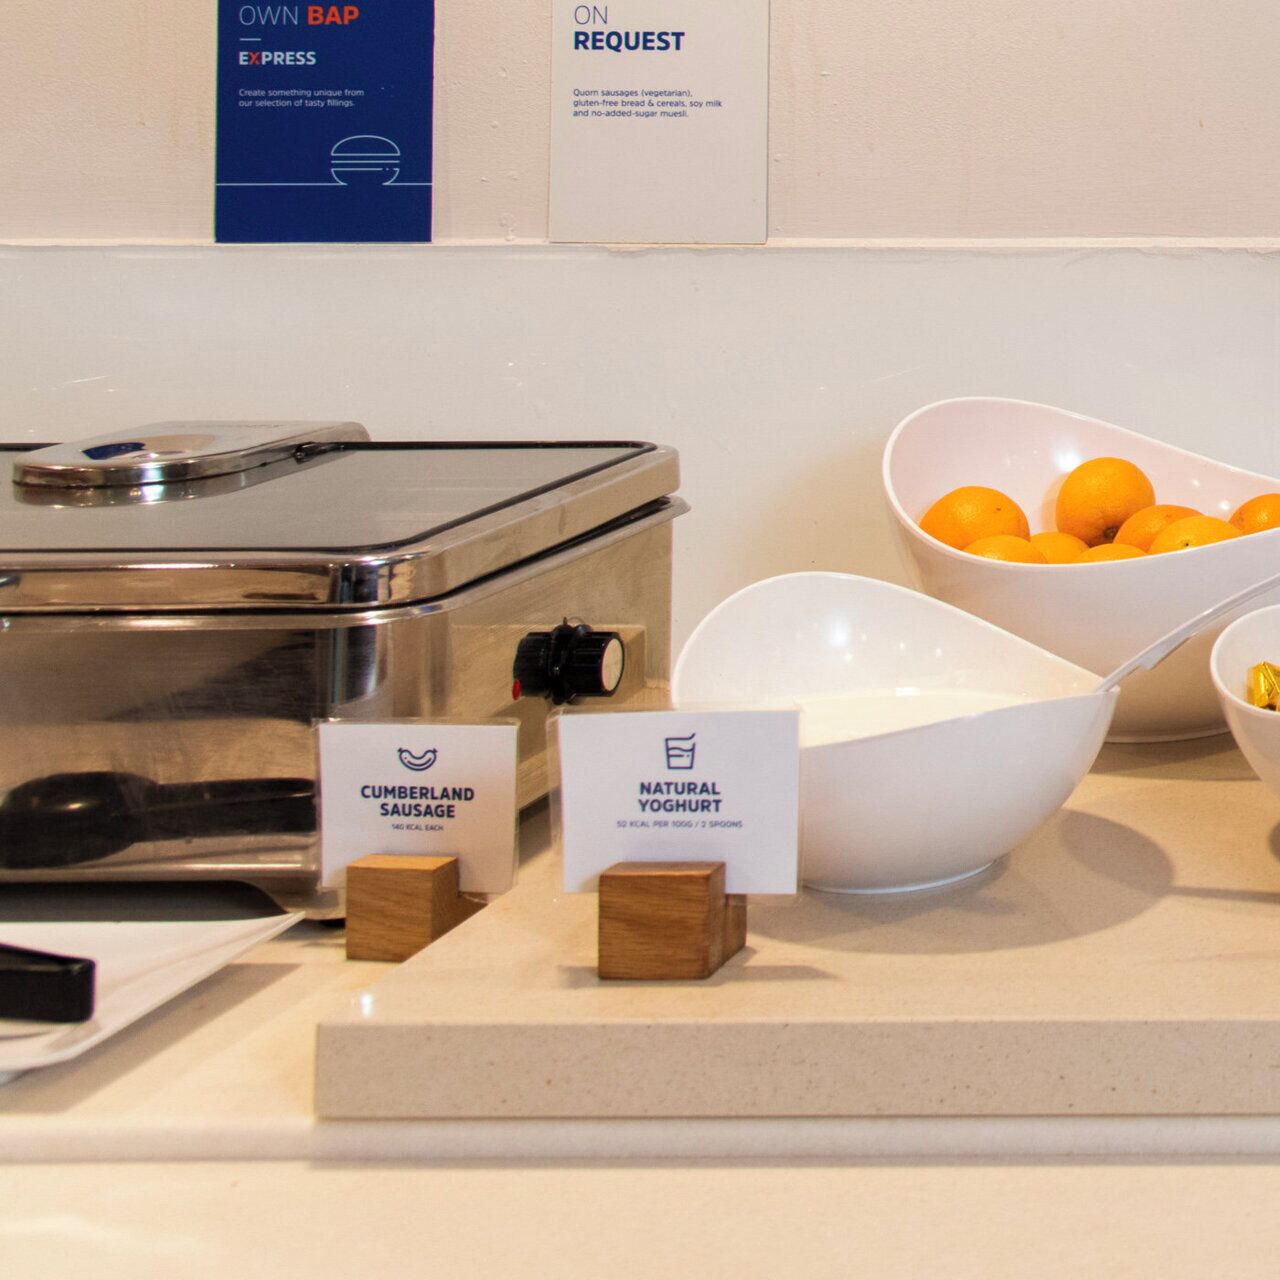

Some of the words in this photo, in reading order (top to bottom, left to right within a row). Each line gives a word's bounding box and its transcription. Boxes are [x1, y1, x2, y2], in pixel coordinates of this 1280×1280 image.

[238, 5, 299, 26] OWN
[306, 5, 360, 26] BAP
[574, 5, 608, 26] ON
[574, 31, 686, 54] REQUEST
[238, 50, 316, 66] EXPRESS
[239, 88, 265, 97] Create
[268, 88, 312, 98] something
[314, 89, 342, 97] unique
[573, 89, 599, 97] Quorn
[255, 99, 292, 107] selection
[294, 99, 303, 107] of
[305, 100, 325, 108] tasty
[573, 100, 618, 108] gluten-free
[591, 110, 657, 118] no-added-sugar
[361, 785, 475, 801] CUMBERLAND
[640, 782, 720, 795] NATURAL
[380, 803, 455, 818] SAUSAGE
[638, 799, 722, 812] YOGHURT
[629, 820, 650, 828] KCAL
[653, 820, 669, 828] PER
[701, 820, 707, 828] 2
[709, 820, 743, 828] SPOONS
